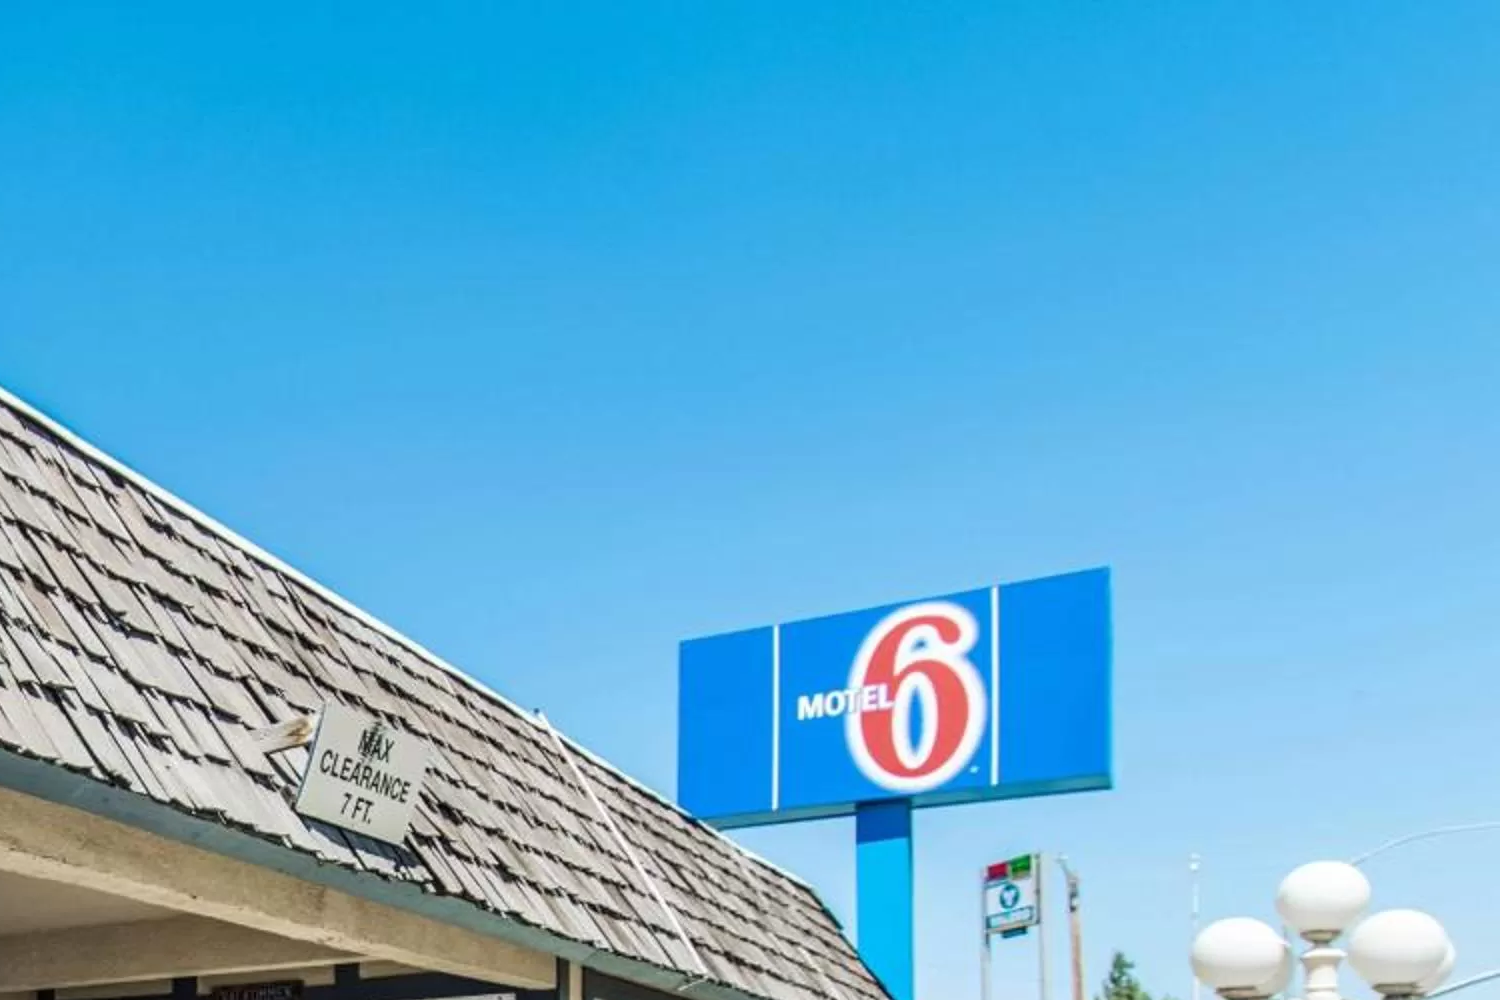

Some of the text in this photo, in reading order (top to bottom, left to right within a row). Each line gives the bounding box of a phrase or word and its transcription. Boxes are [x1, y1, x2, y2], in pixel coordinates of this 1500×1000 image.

[797, 601, 987, 792] MOTEL 6
[358, 728, 395, 763] MAX
[319, 749, 411, 804] CLEARANCE
[340, 792, 375, 825] 7 FT.
